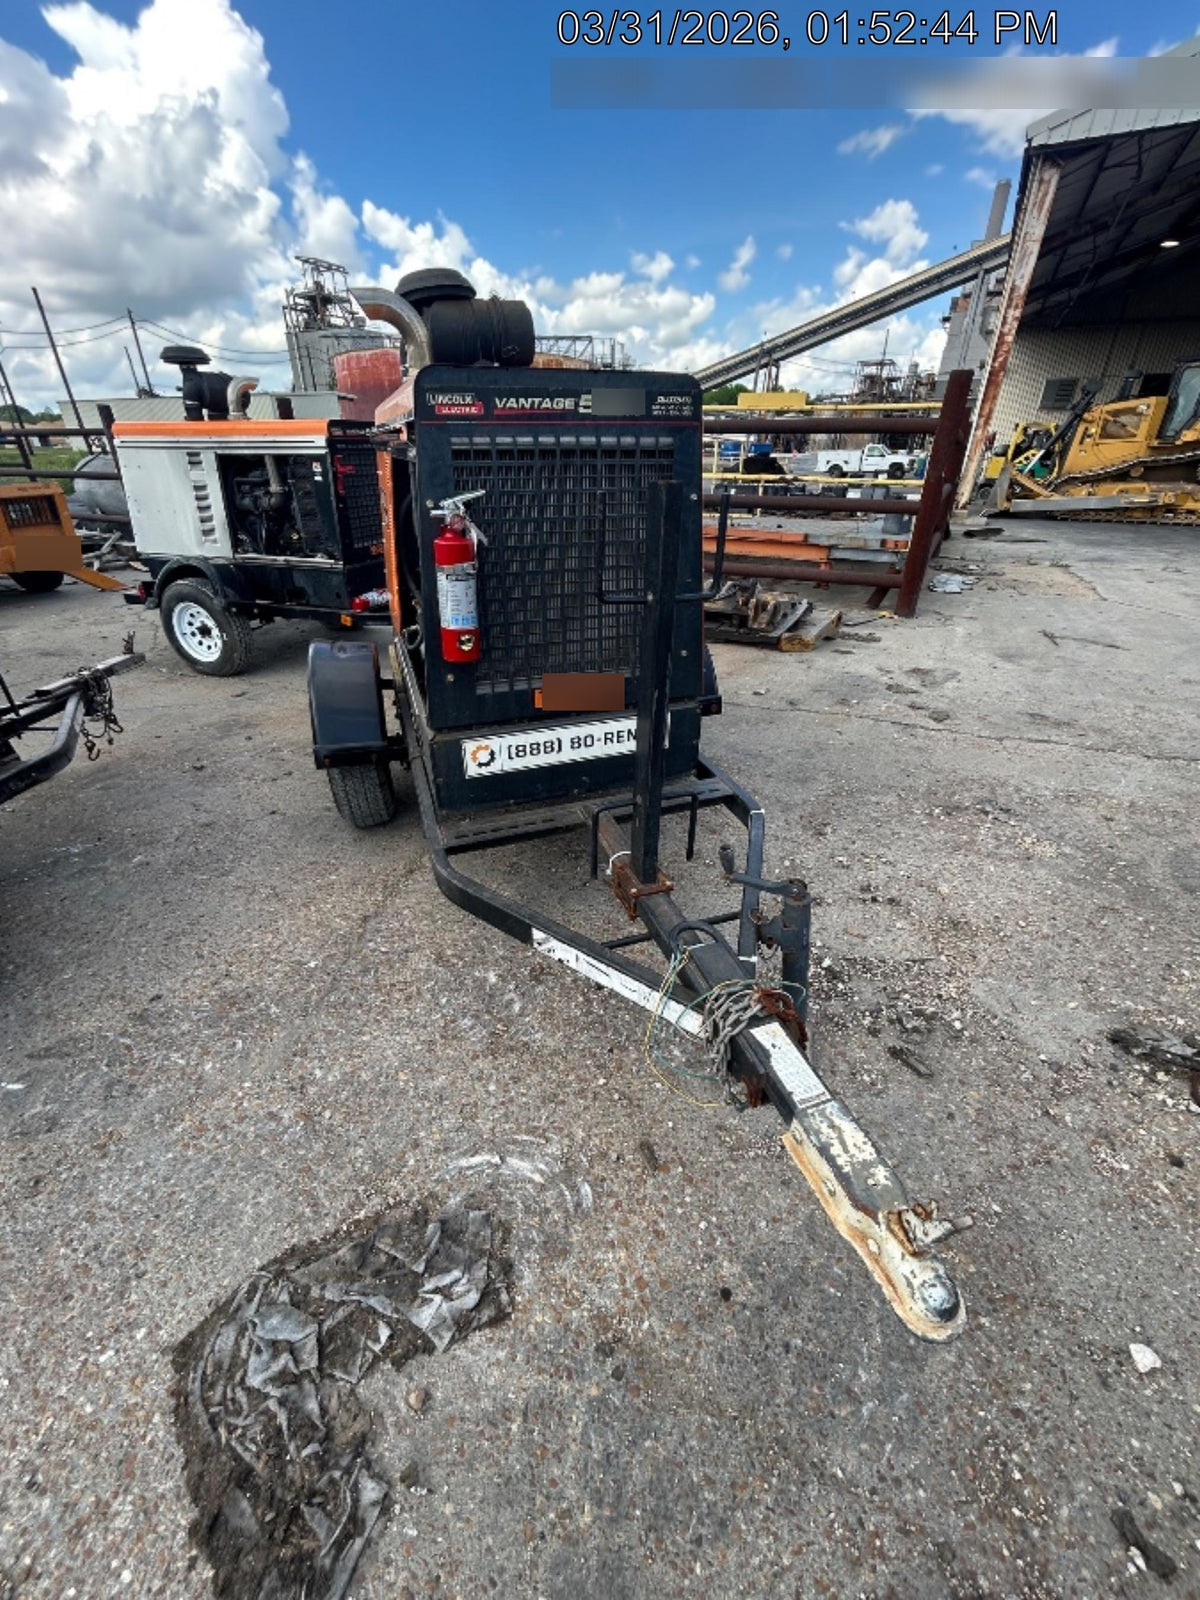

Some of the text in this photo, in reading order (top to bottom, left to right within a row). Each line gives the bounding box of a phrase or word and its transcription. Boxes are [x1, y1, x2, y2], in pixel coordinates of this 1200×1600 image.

[495, 397, 576, 410] VANTAGE
[507, 728, 637, 760] (888) 80-REN
